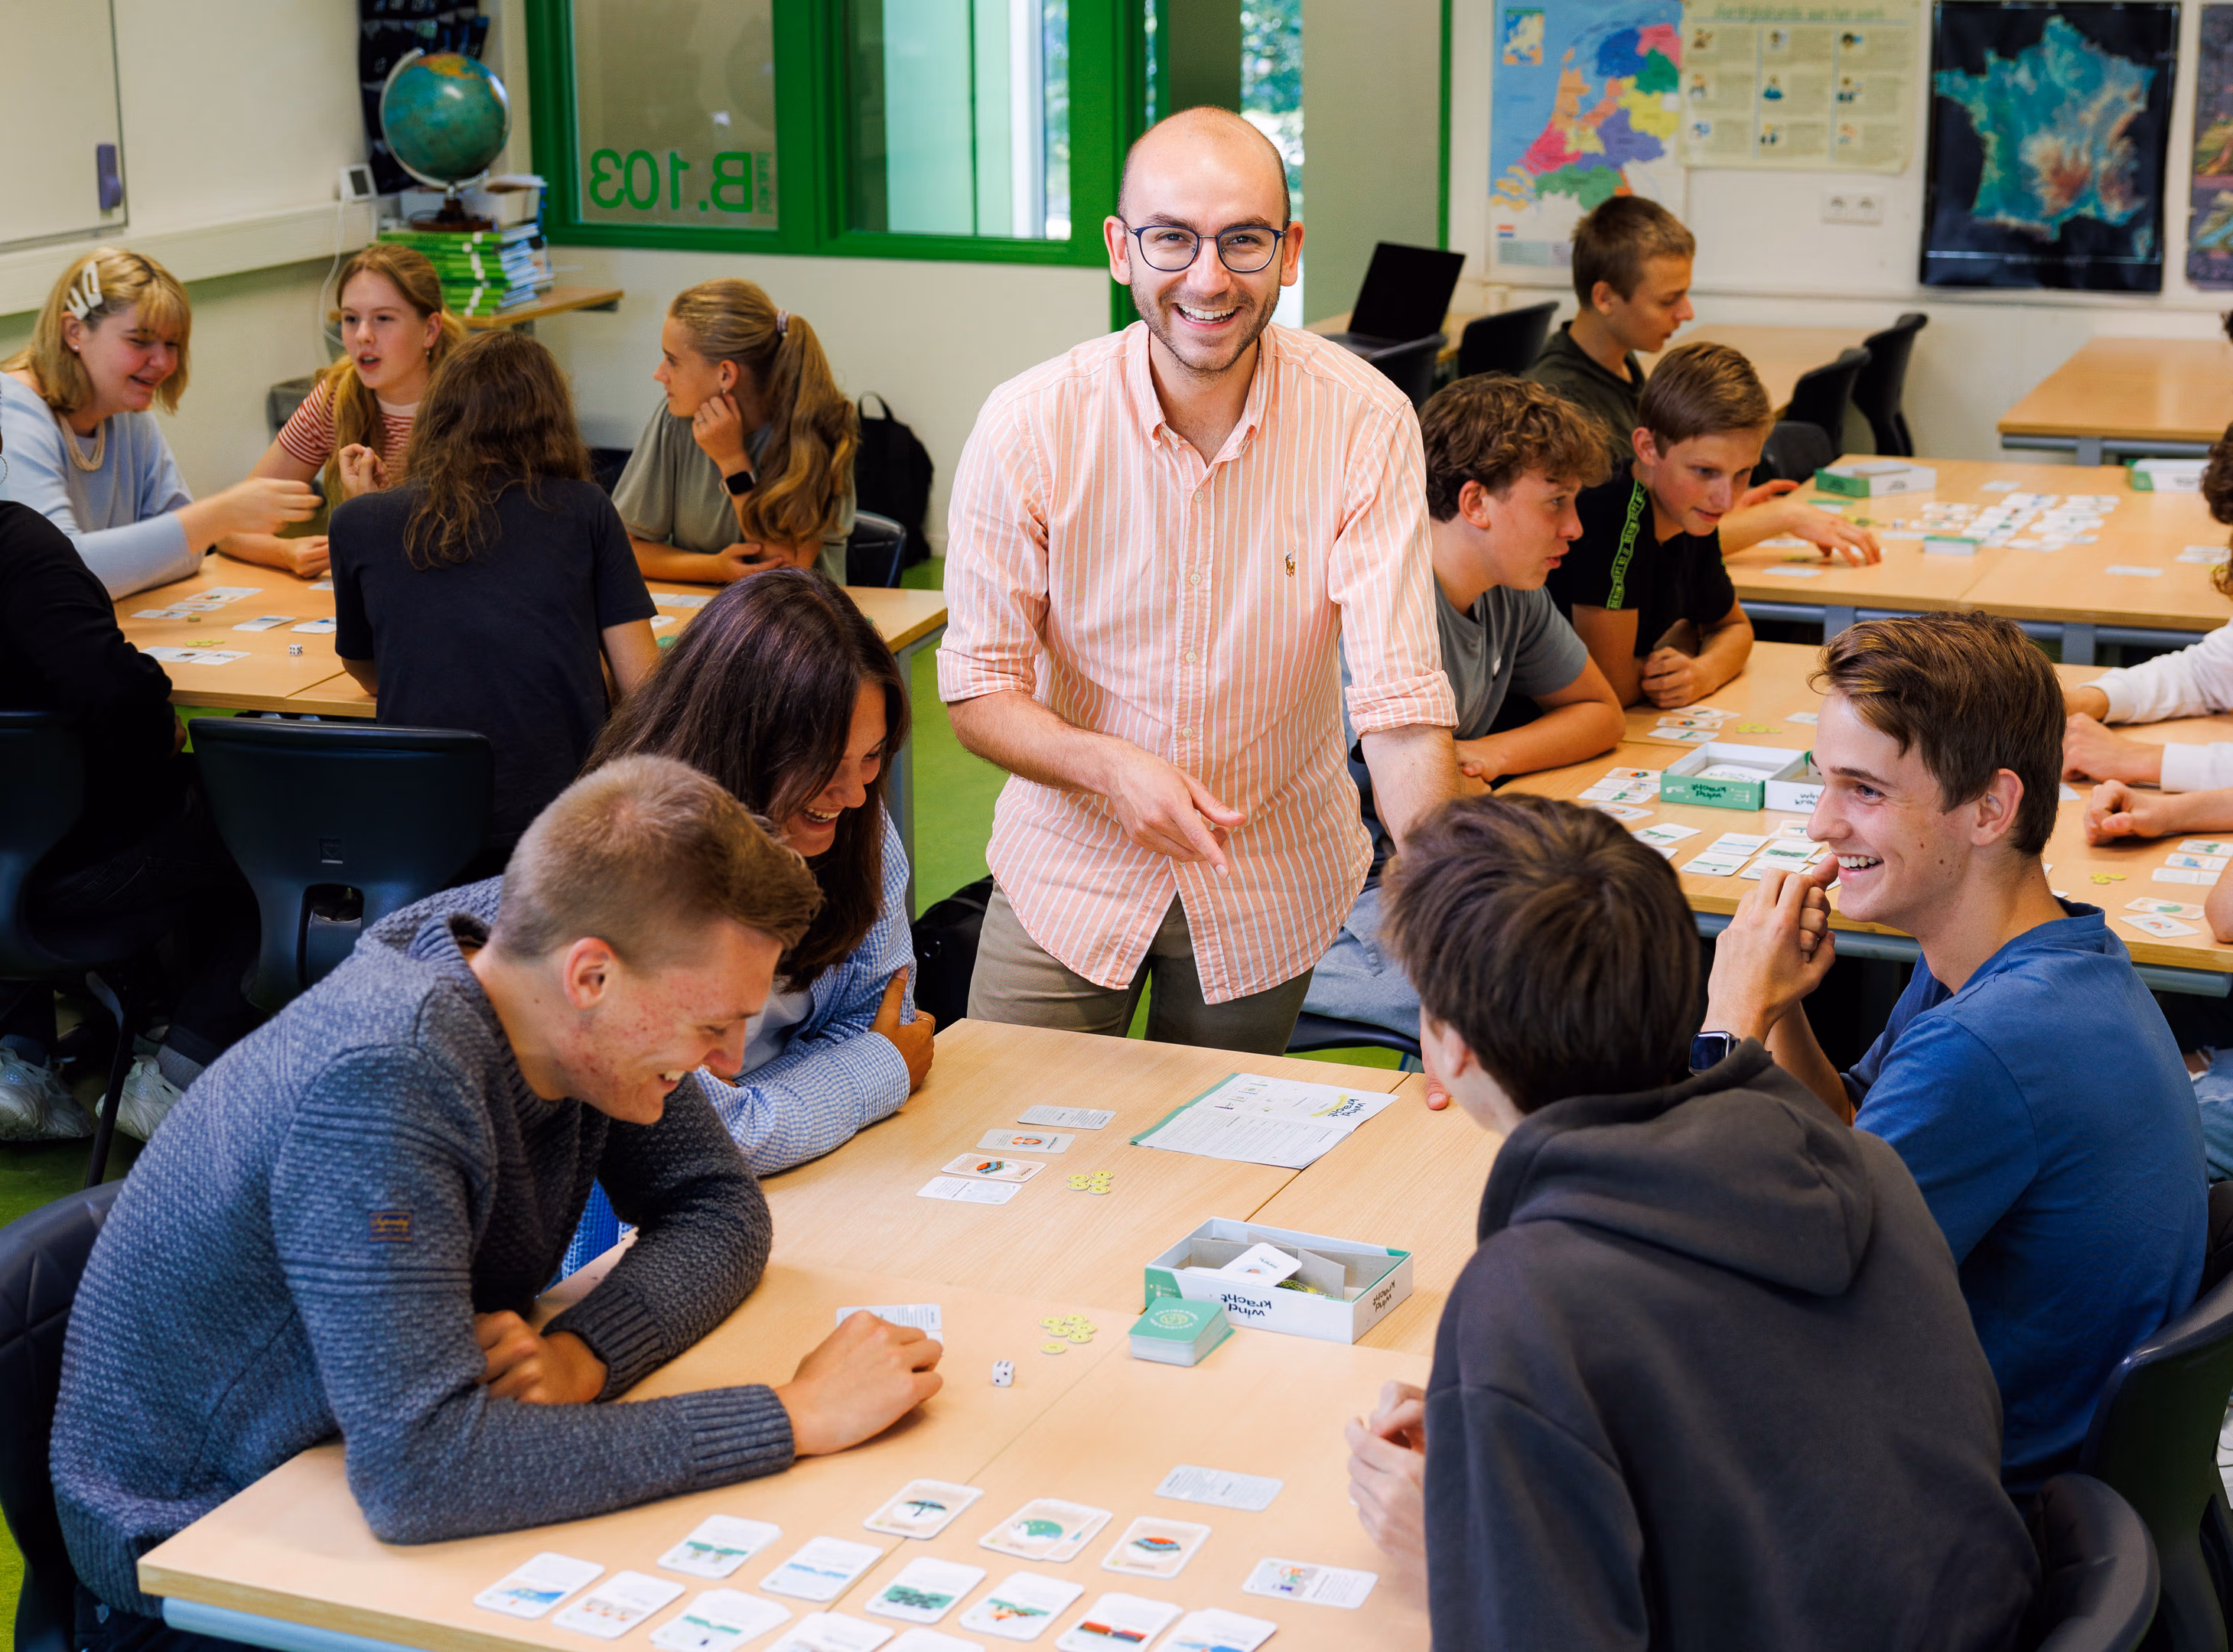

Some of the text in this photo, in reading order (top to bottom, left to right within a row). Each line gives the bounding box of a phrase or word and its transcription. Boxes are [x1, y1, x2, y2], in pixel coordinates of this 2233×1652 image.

[1800, 791, 1819, 799] win
[1327, 1098, 1359, 1117] kracht
[1341, 1102, 1366, 1117] wind
[1220, 1293, 1272, 1309] kracht
[1372, 1279, 1395, 1306] kracht
[1229, 1302, 1265, 1319] wind
[1375, 1293, 1392, 1313] wind
